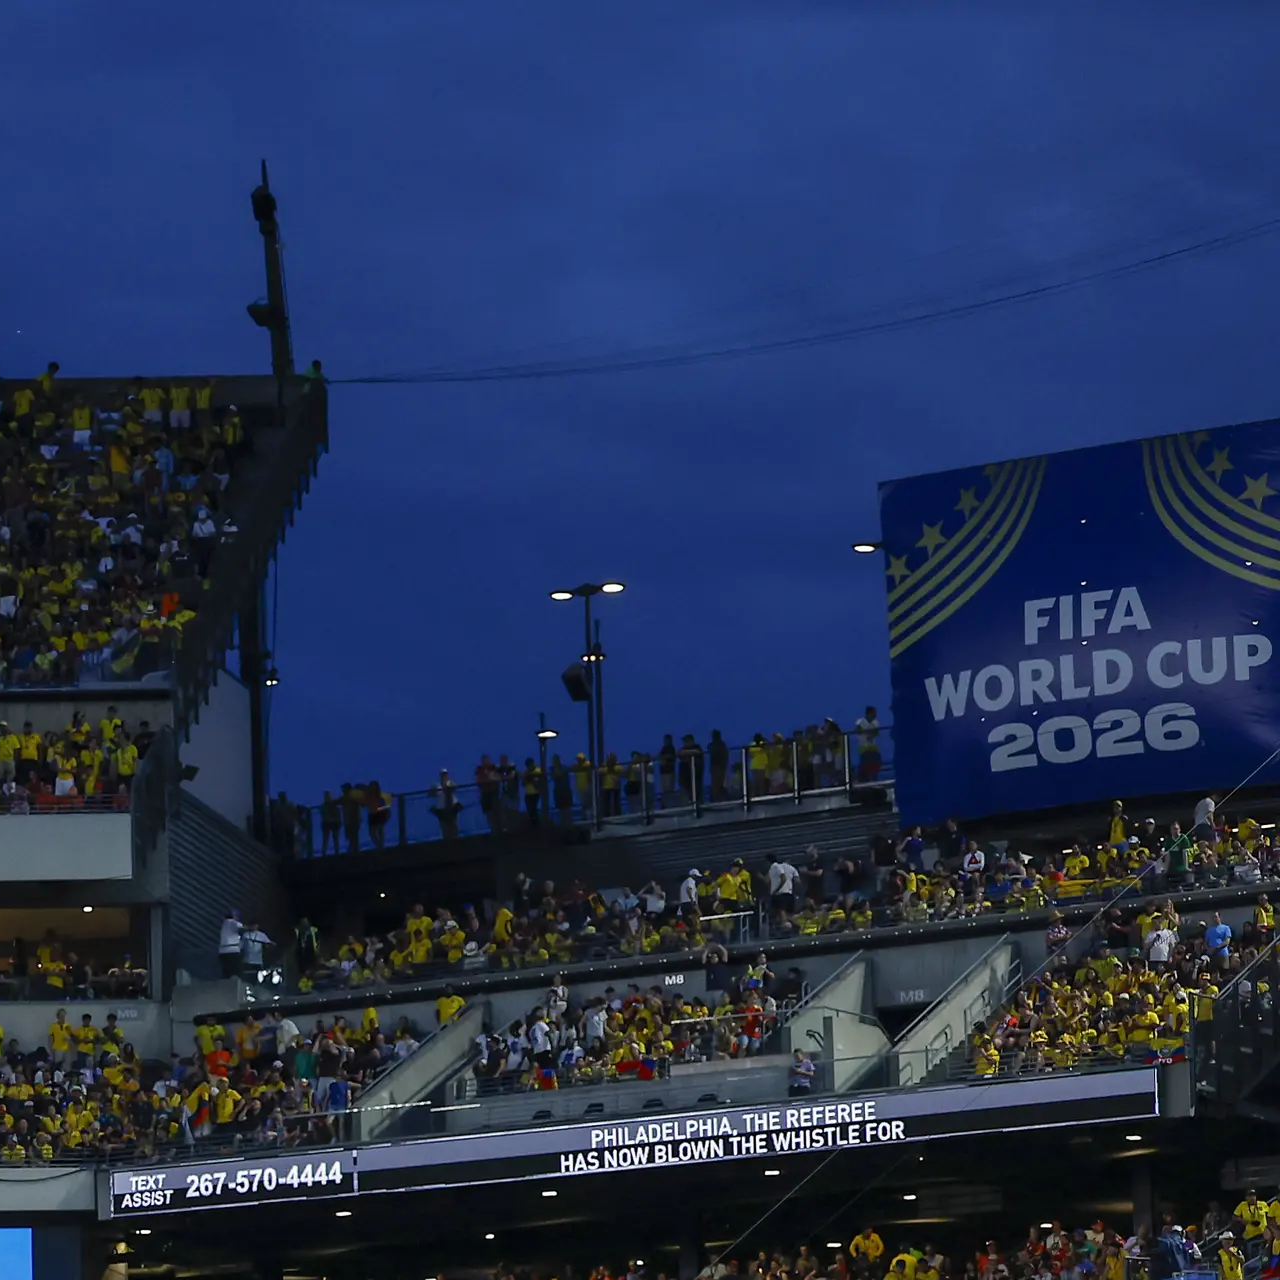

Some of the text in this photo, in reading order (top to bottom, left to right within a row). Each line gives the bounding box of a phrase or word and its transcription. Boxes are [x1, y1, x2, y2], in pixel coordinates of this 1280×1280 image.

[1024, 586, 1151, 646] FIFA
[924, 633, 1273, 722] WORLD CUP
[987, 702, 1201, 773] 2026
[664, 974, 684, 984] M8
[559, 1120, 906, 1174] HAS NOW BLOWN THE WHISTLE FOR
[590, 1101, 876, 1149] PHILADELPHIA, THE REFEREE
[120, 1189, 175, 1209] ASSIST
[128, 1159, 344, 1198] TEXT 267-570-4444
